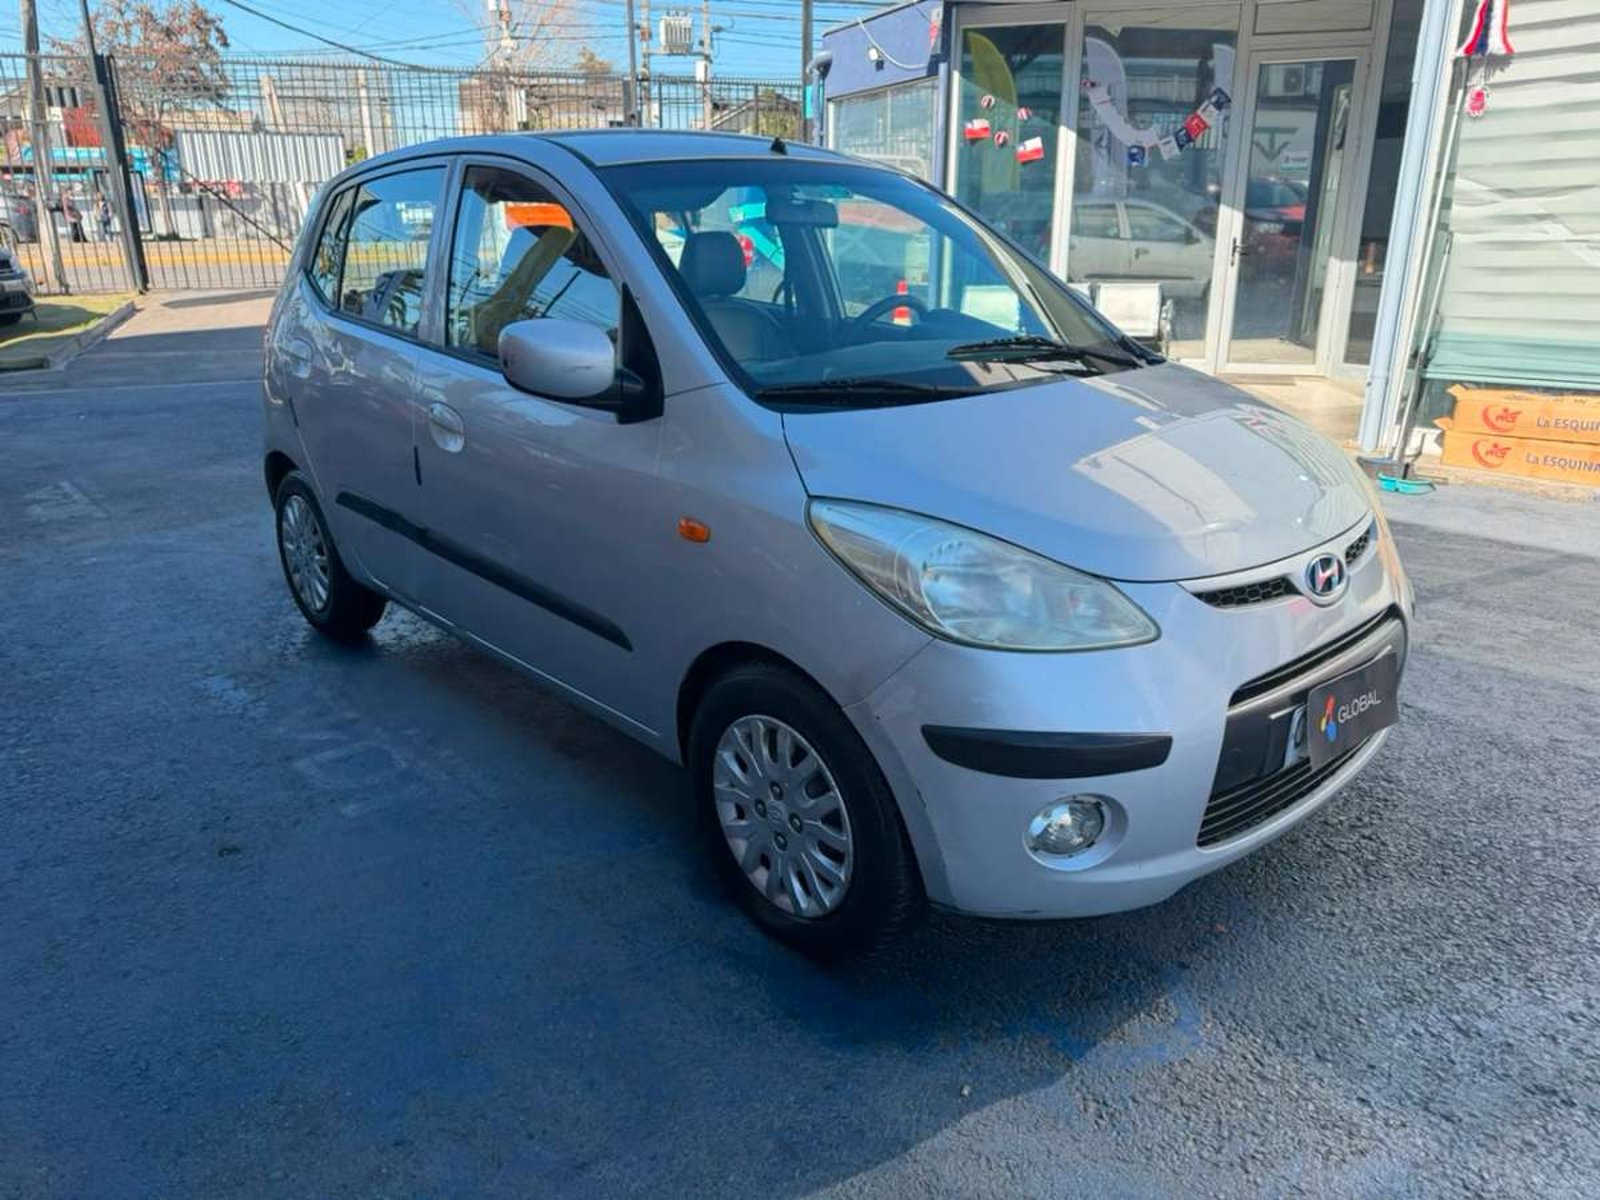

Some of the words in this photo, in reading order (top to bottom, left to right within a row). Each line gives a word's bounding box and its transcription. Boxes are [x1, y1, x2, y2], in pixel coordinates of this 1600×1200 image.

[1536, 415, 1550, 428] La
[1525, 451, 1539, 465] La
[1338, 689, 1381, 723] GLOBAL
